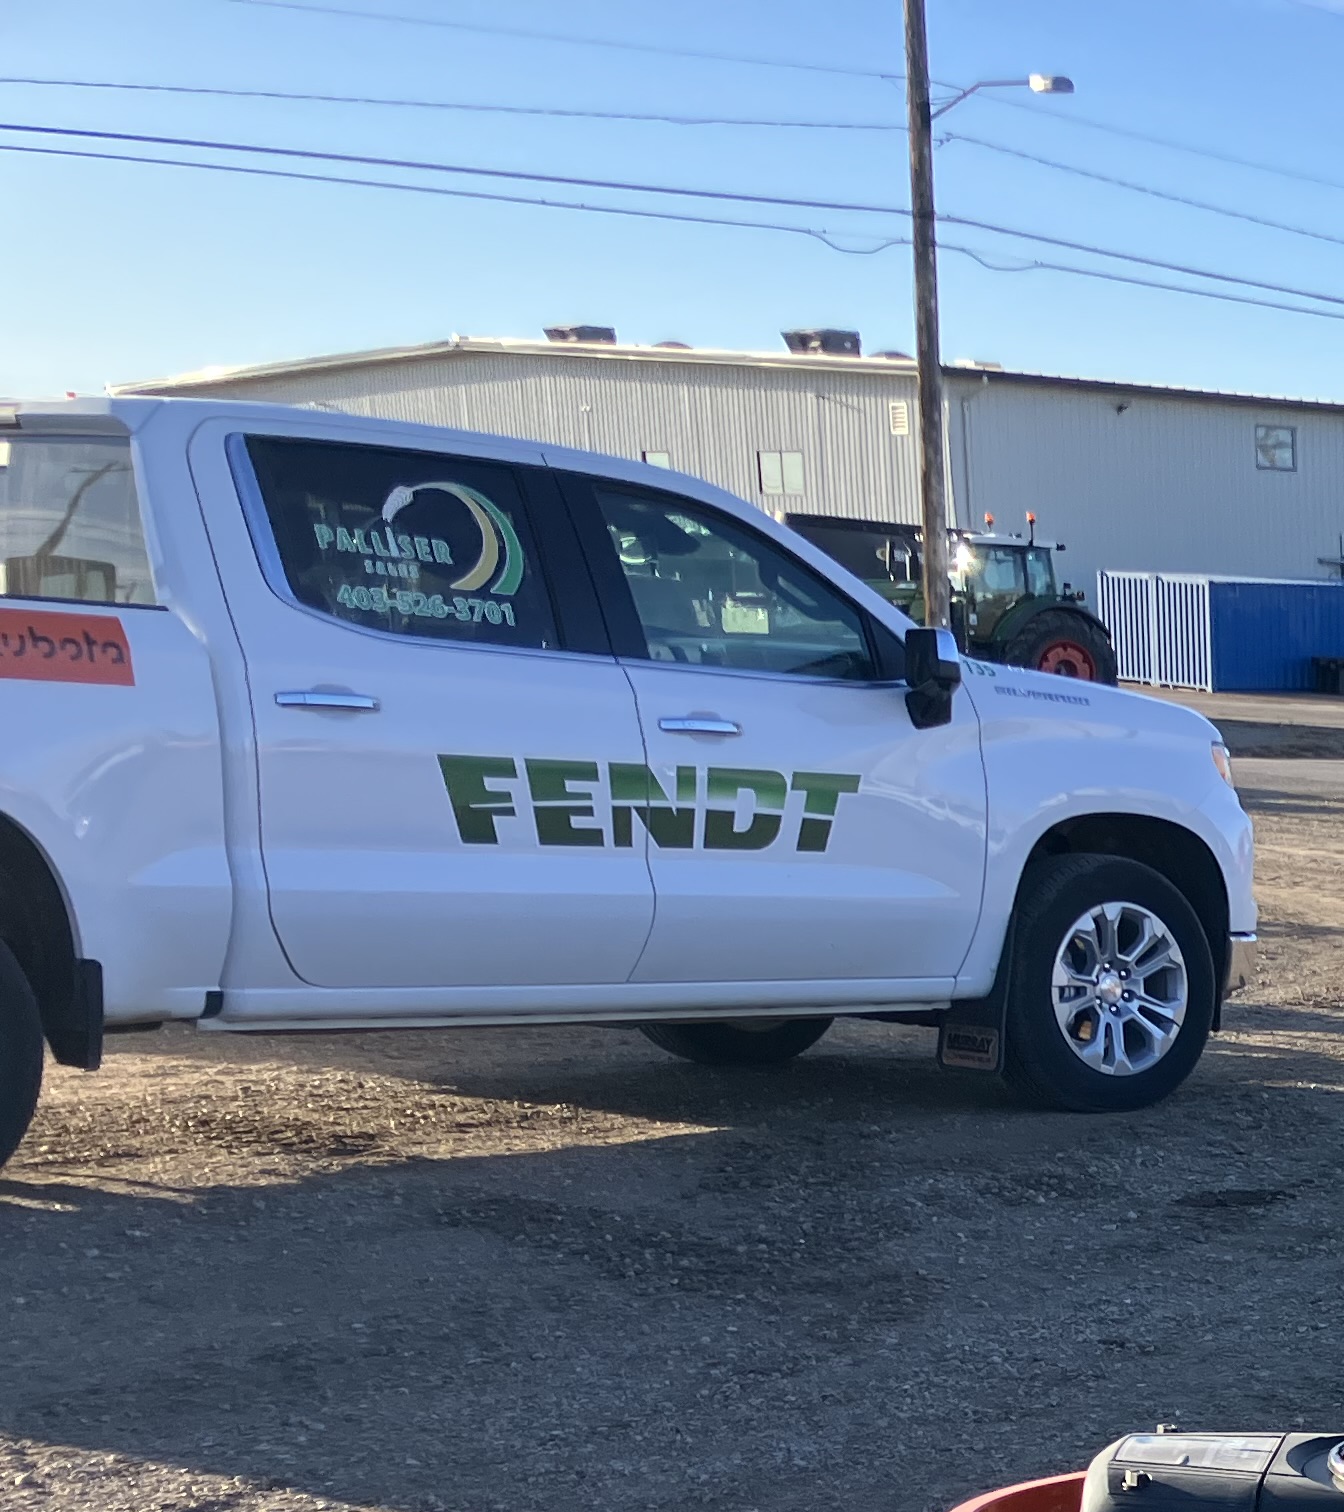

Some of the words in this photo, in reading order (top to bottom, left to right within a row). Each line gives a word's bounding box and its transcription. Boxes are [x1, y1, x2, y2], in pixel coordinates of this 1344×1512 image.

[313, 523, 454, 565] PALLISER
[336, 584, 516, 627] 403-526-3701
[0, 626, 126, 664] ubota
[437, 753, 862, 853] FENDT
